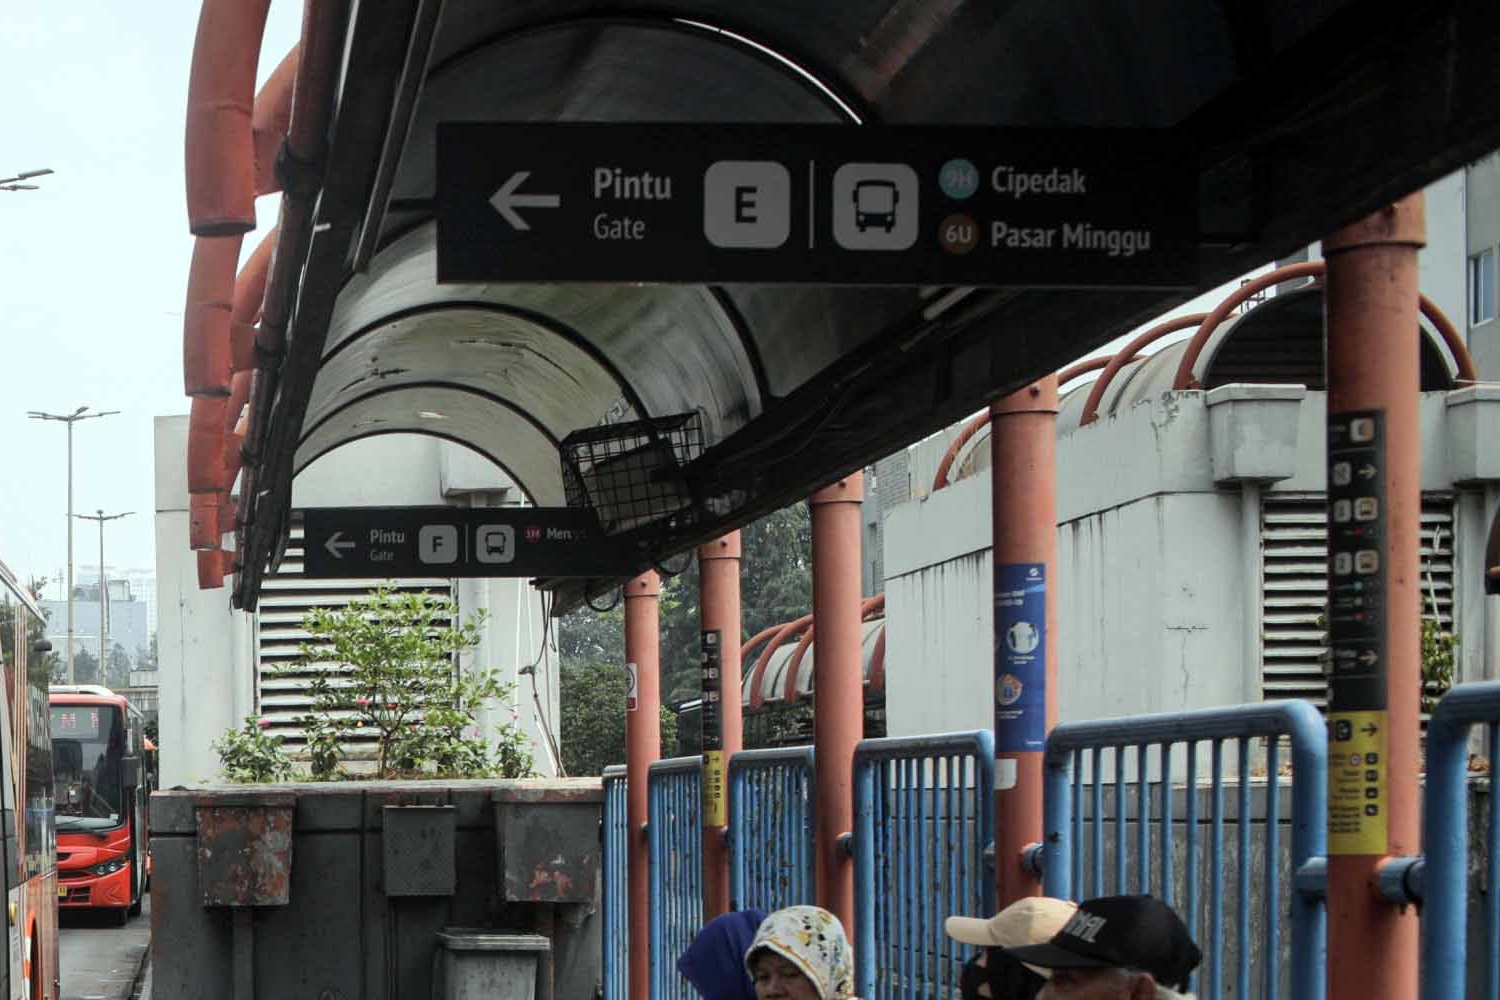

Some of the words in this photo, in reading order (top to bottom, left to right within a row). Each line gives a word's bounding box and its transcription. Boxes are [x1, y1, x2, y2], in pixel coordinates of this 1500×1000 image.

[594, 168, 671, 199] Pintu
[991, 166, 1086, 198] Cipedak
[734, 186, 758, 223] E
[594, 213, 645, 239] Gate
[946, 225, 972, 243] 6U
[991, 221, 1056, 247] Pasar
[1062, 223, 1151, 256] Minggu
[370, 529, 405, 544] Pintu
[432, 537, 443, 552] F
[370, 549, 394, 561] Gate
